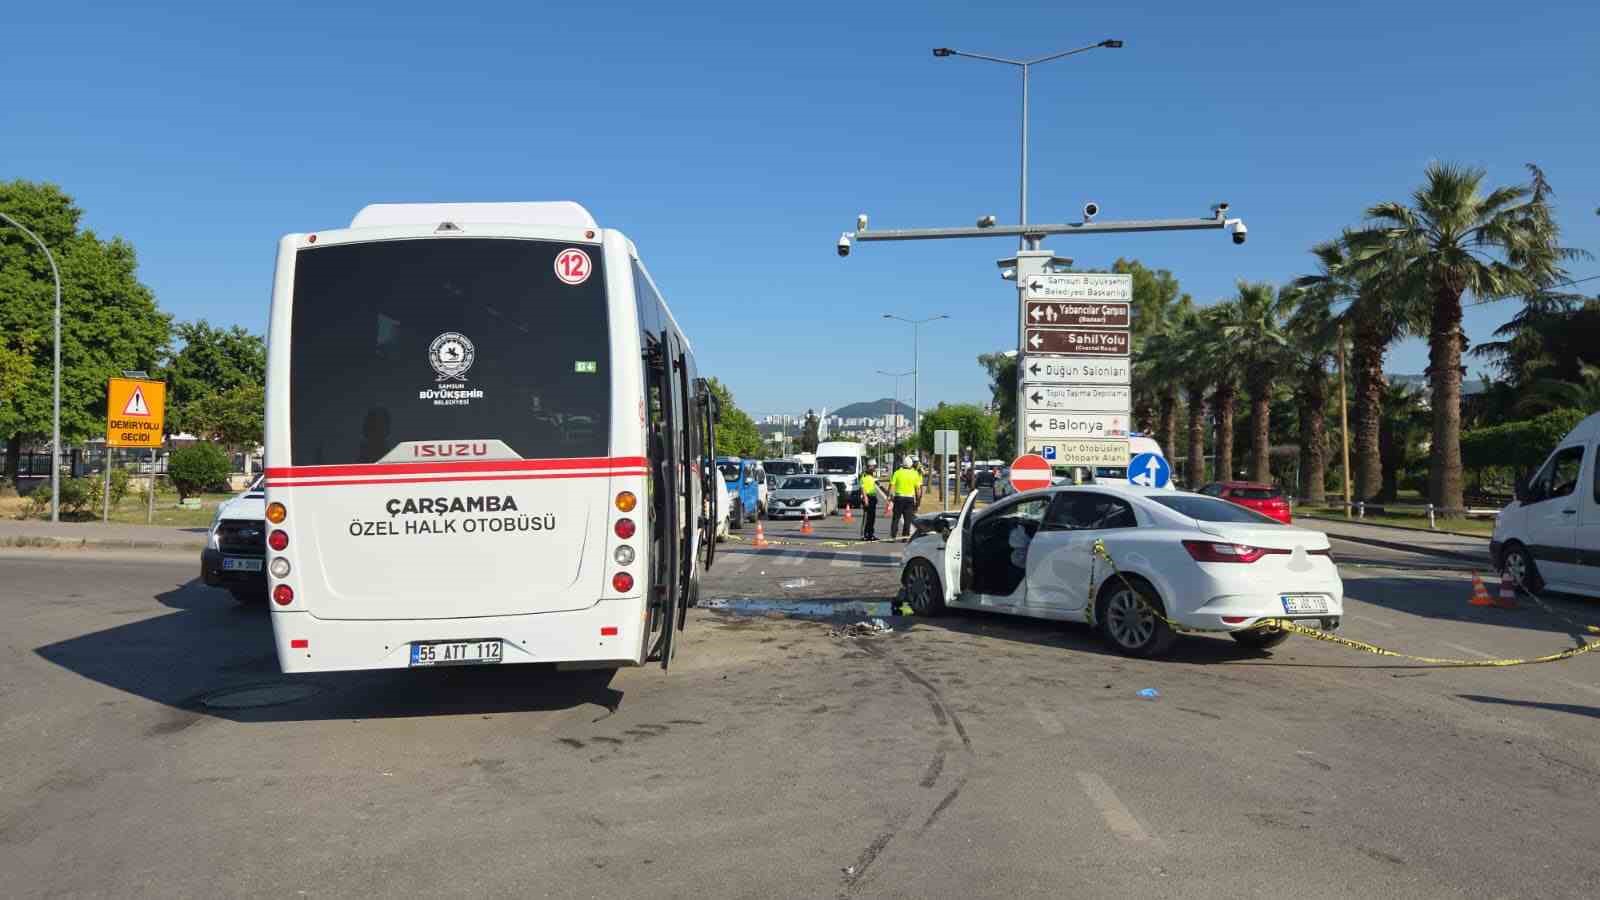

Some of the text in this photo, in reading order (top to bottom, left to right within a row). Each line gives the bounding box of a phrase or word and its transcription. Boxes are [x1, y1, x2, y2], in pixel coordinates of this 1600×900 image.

[560, 254, 583, 275] 12
[1068, 333, 1126, 345] Sahil Yolu
[1083, 365, 1126, 377] Salonları
[419, 388, 484, 400] BÜYÜKŞEHİR
[1049, 417, 1104, 434] Balonya
[414, 443, 487, 457] ISUZU
[1044, 446, 1055, 458] P
[1062, 443, 1078, 452] Tur
[1064, 454, 1100, 463] Otopark
[386, 495, 518, 518] ÇARŞAMBA
[349, 513, 556, 536] ÖZEL HALK OTOBÜSÜ
[420, 643, 499, 661] 55 ATT 112
